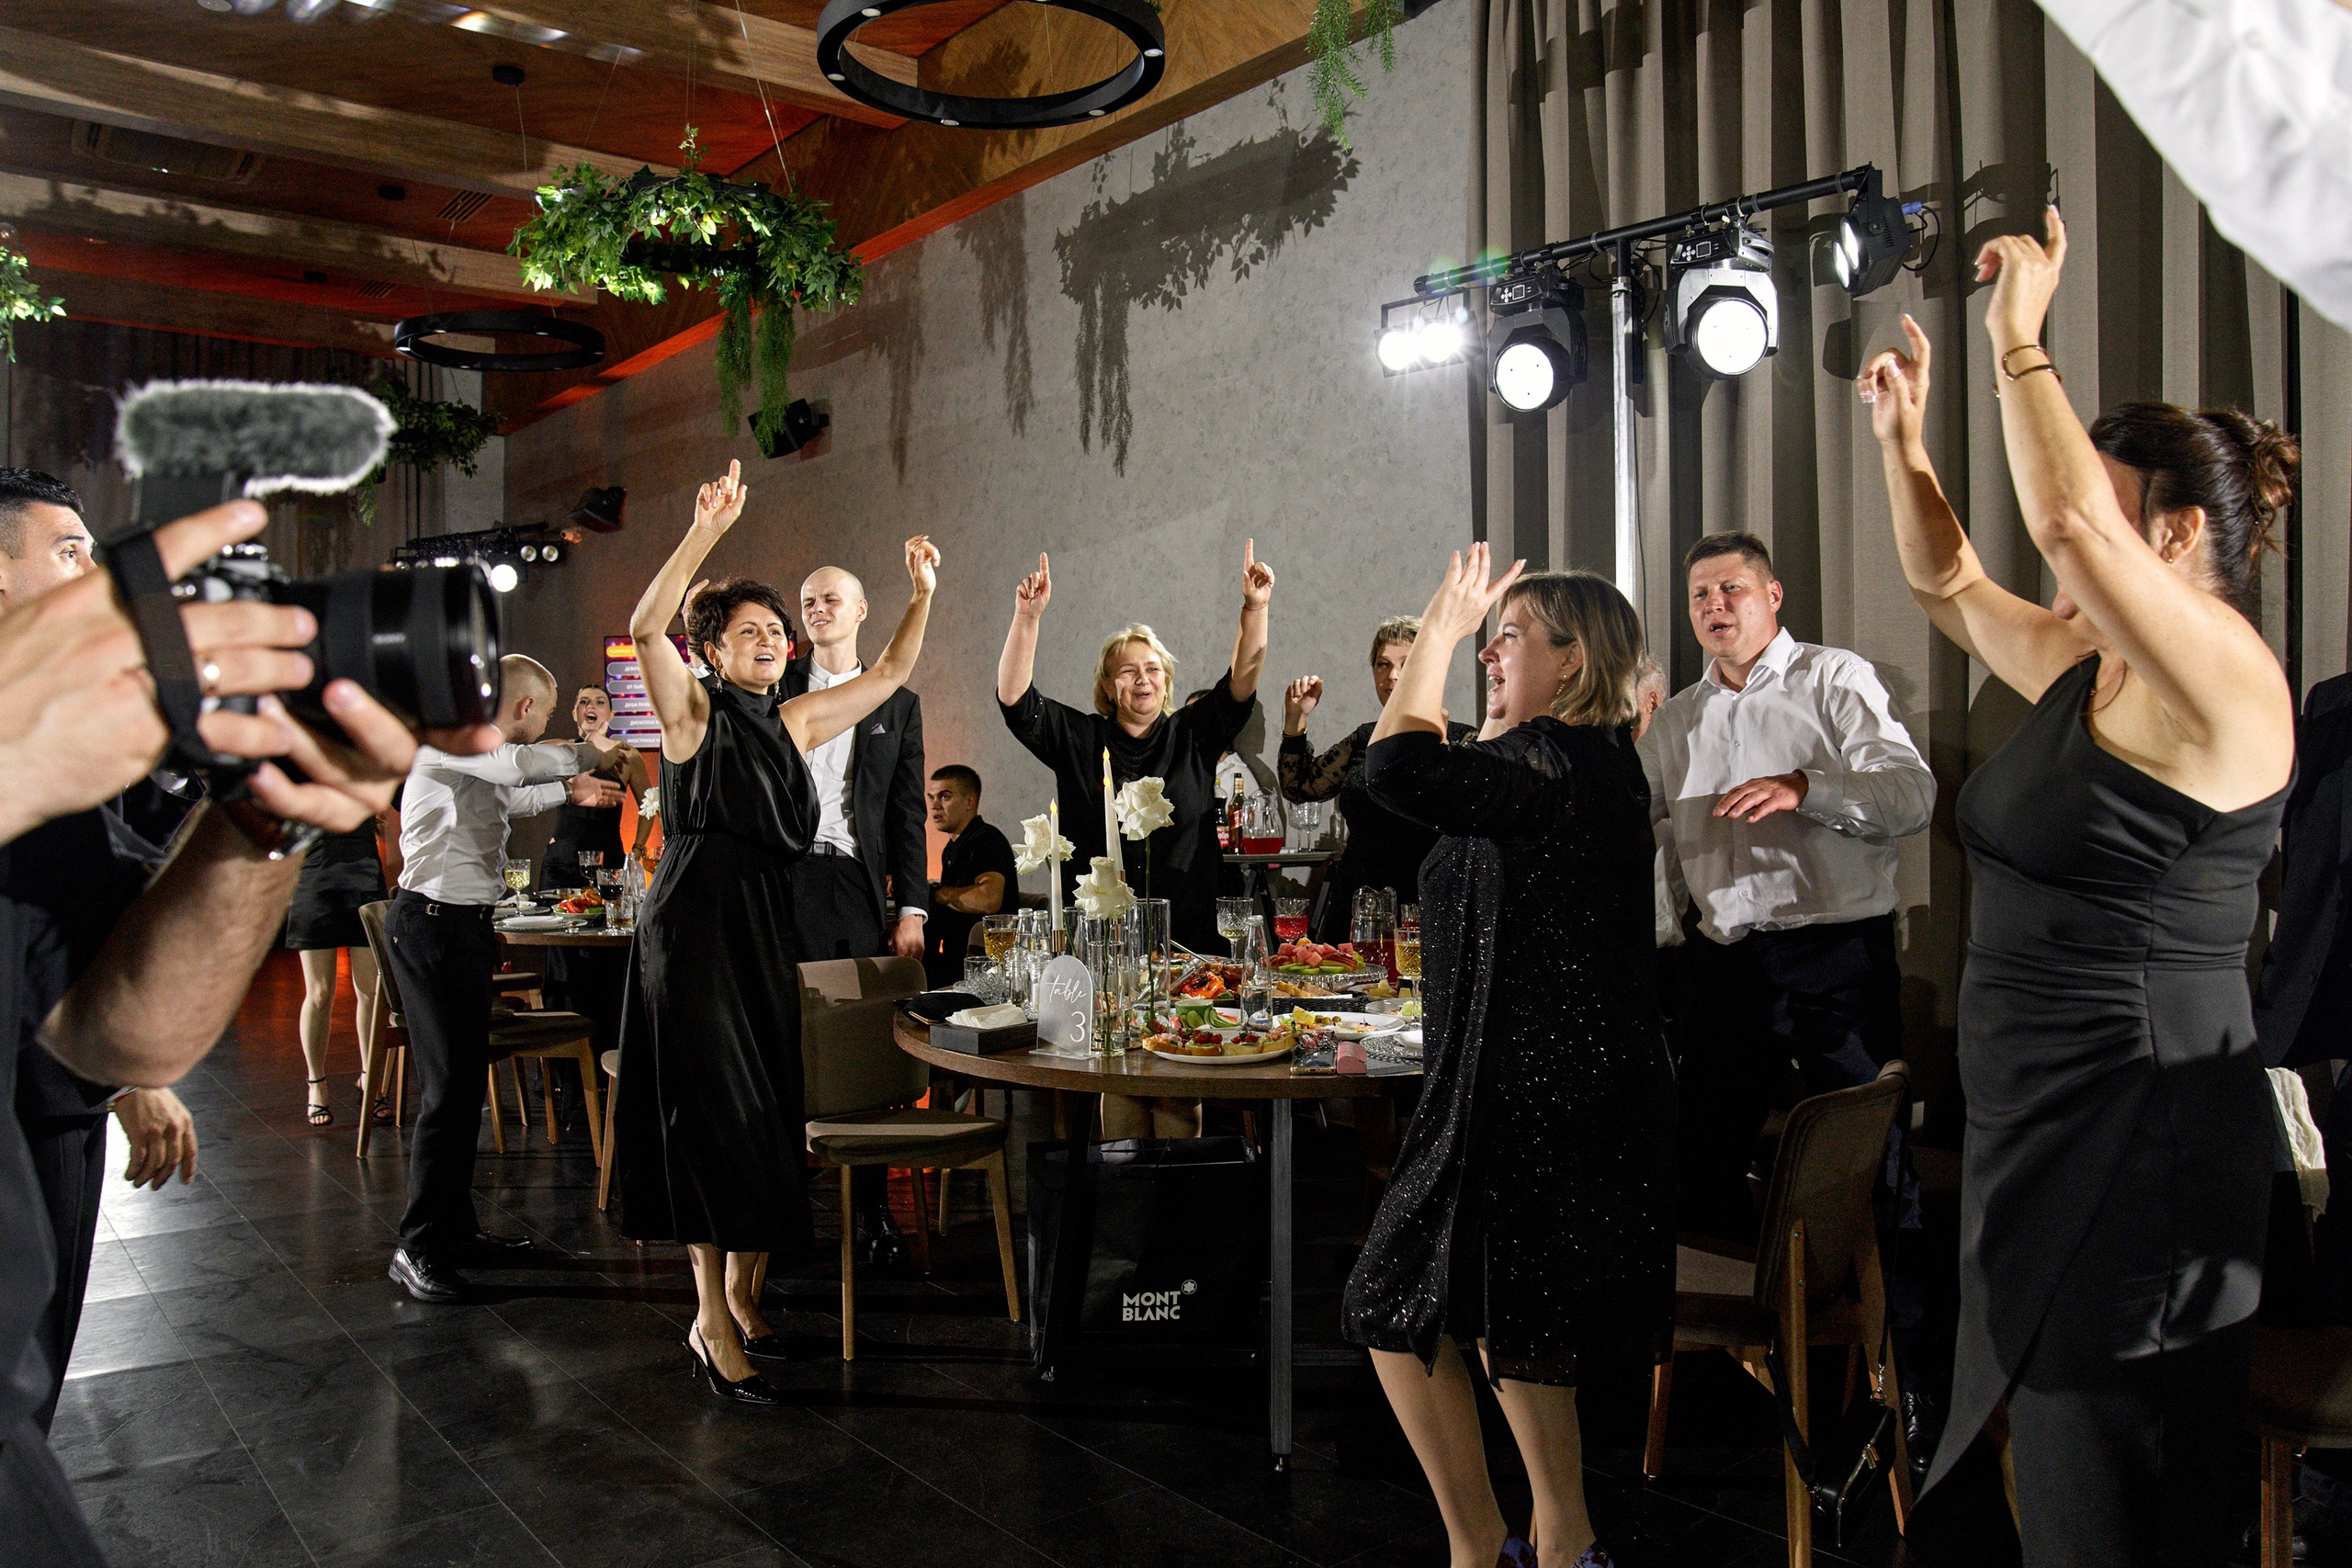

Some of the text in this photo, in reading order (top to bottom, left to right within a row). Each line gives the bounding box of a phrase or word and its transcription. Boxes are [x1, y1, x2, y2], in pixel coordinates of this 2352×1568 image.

[1046, 975, 1087, 1004] table
[1069, 1011, 1086, 1043] 3
[1123, 1291, 1181, 1306] MONT
[1122, 1305, 1181, 1321] BLANC
